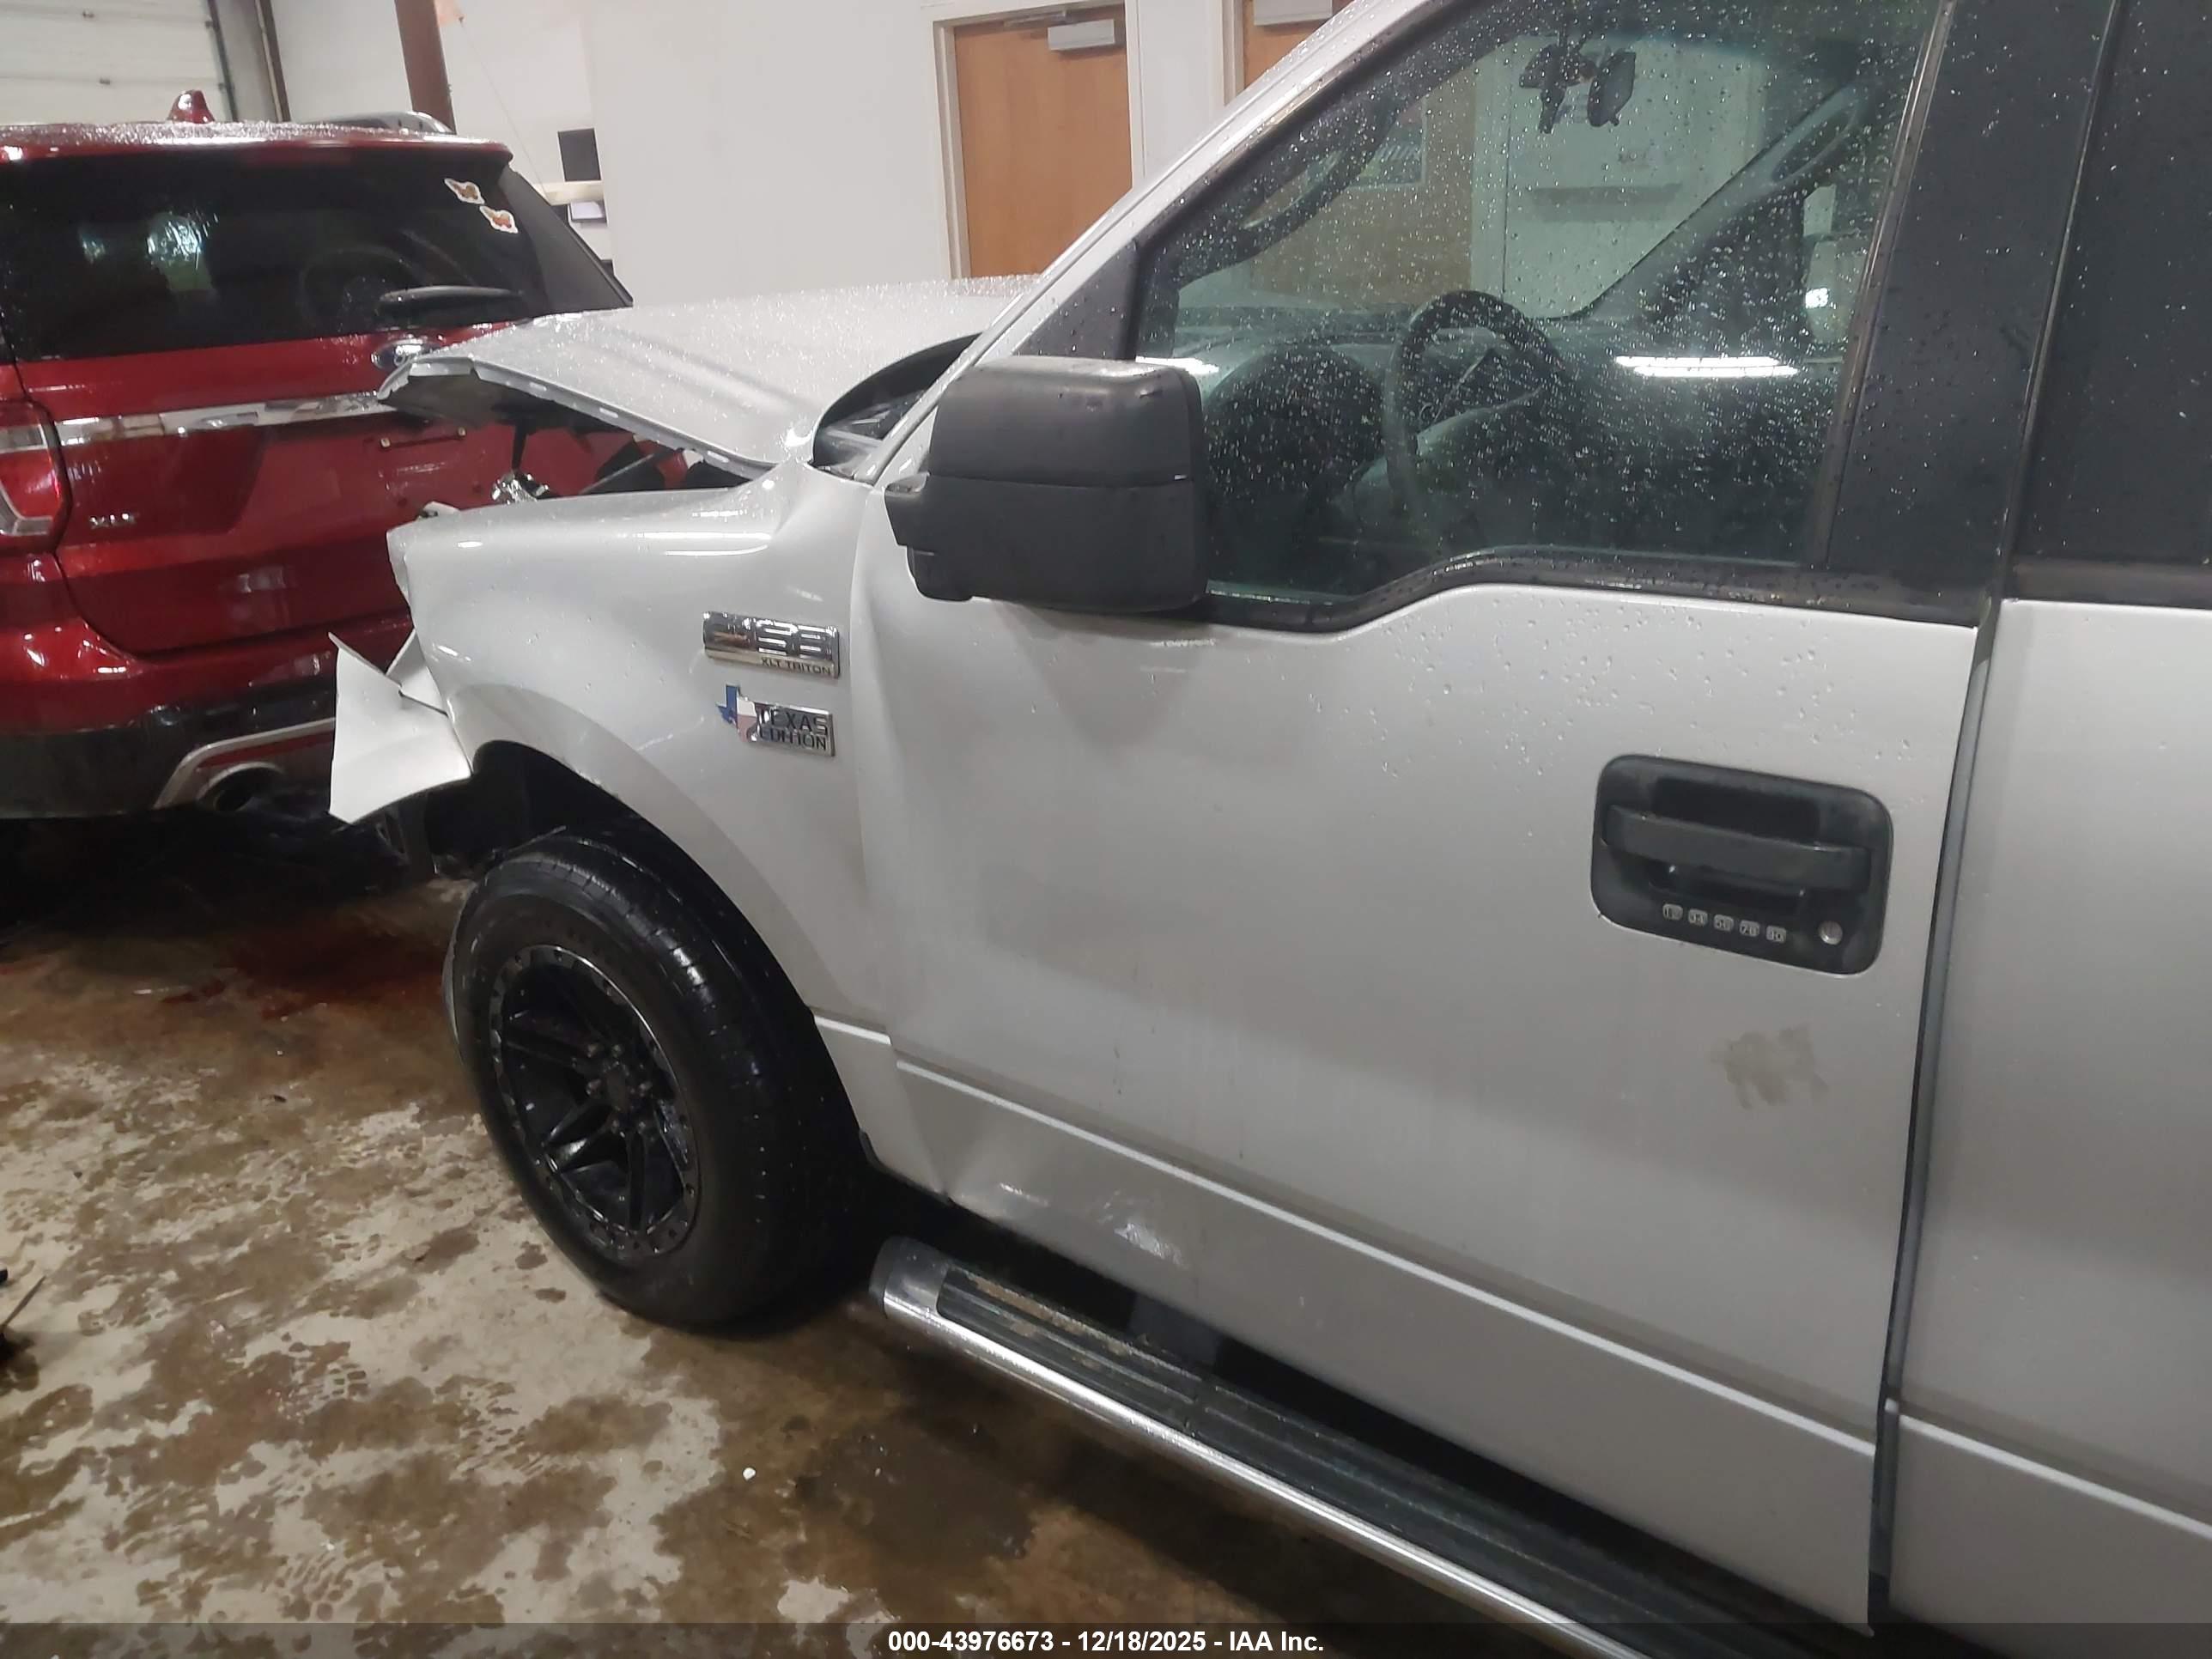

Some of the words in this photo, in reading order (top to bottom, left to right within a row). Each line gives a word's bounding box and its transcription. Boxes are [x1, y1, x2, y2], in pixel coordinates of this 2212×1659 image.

[761, 657, 781, 669] XLT
[786, 659, 831, 676] TRITON
[757, 706, 828, 736] TEXAS
[759, 727, 826, 751] EDITION
